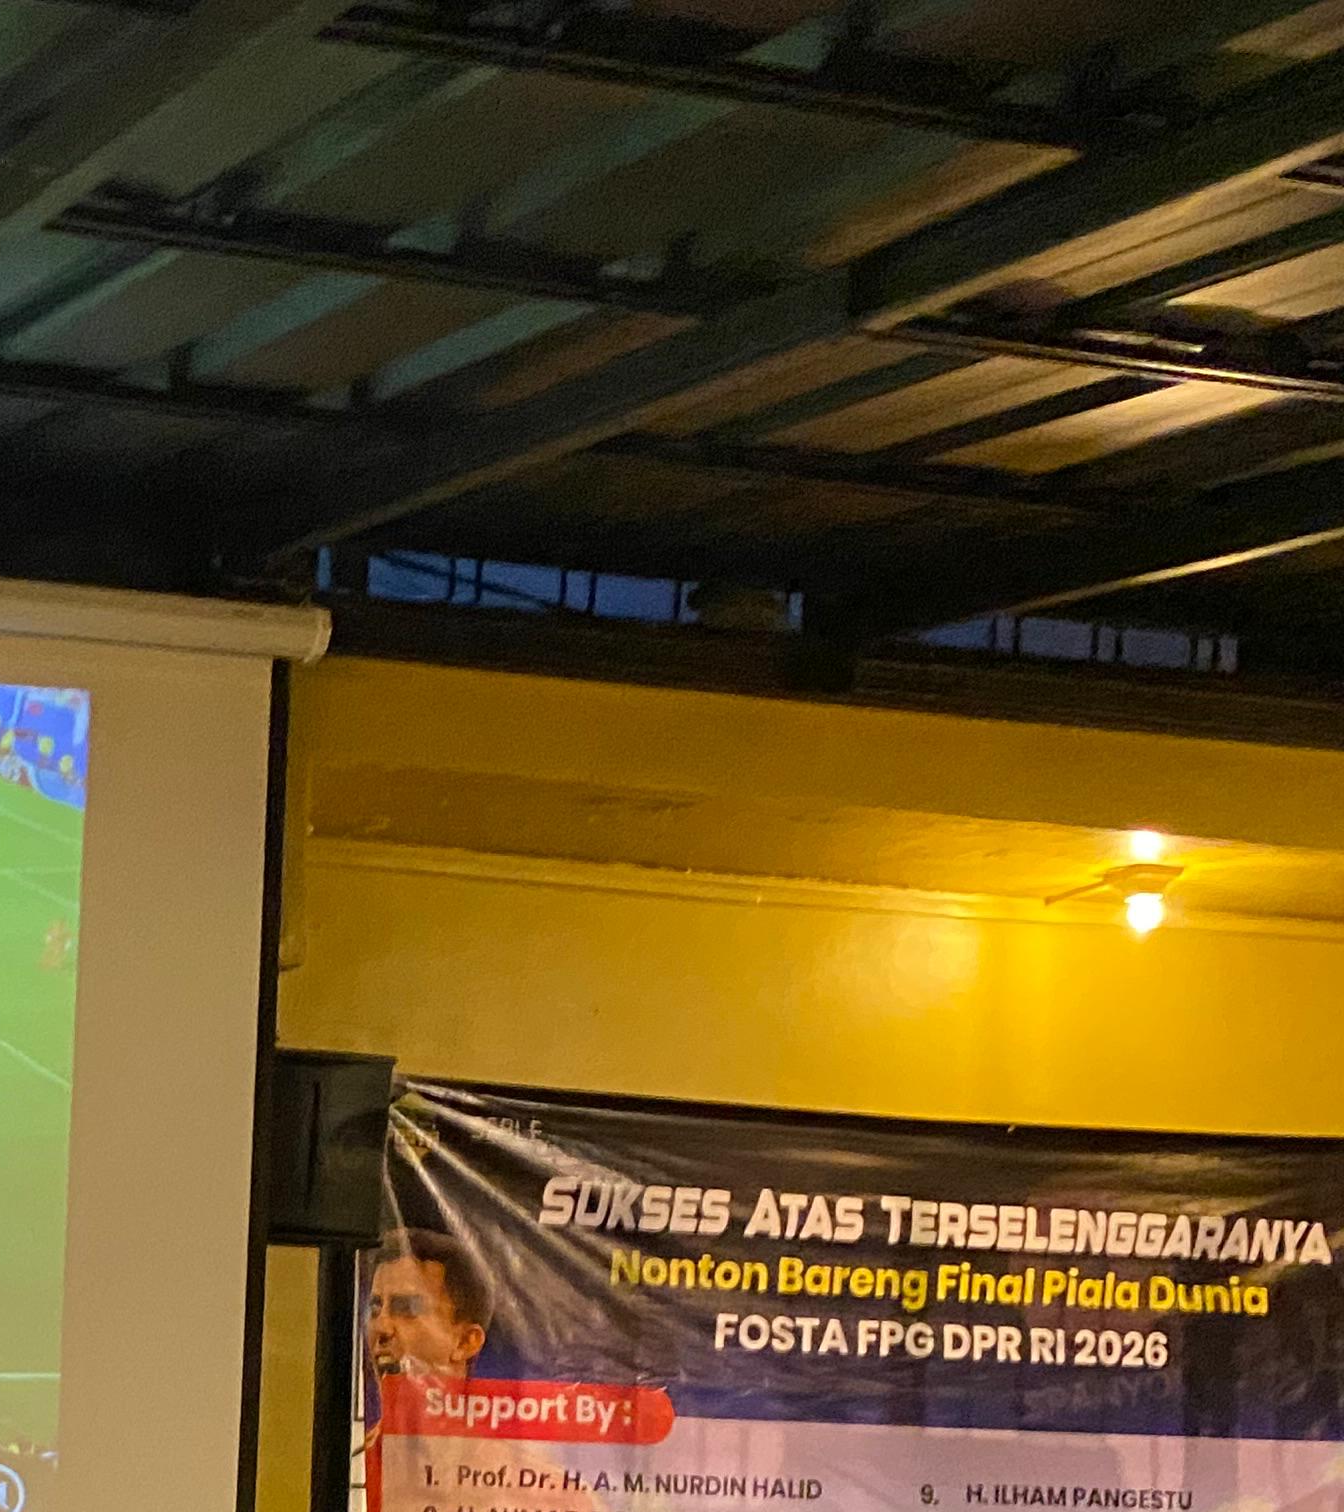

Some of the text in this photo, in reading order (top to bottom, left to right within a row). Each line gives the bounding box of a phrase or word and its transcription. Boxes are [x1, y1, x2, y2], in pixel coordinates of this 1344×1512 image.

[539, 1176, 1333, 1265] SUKSES ATAS TERSELENGGARANYA
[611, 1250, 1269, 1317] Nonton Bareng Final Piala Dunia
[715, 1312, 1169, 1368] FOSTA FPG DPR RI 2026
[425, 1388, 566, 1429] Support
[424, 1465, 823, 1500] 1. Prof. Dr. H. A. M. NURDIN HALID
[966, 1484, 988, 1505] H.
[994, 1484, 1067, 1507] ILHAM
[1072, 1488, 1193, 1511] PANGESTU
